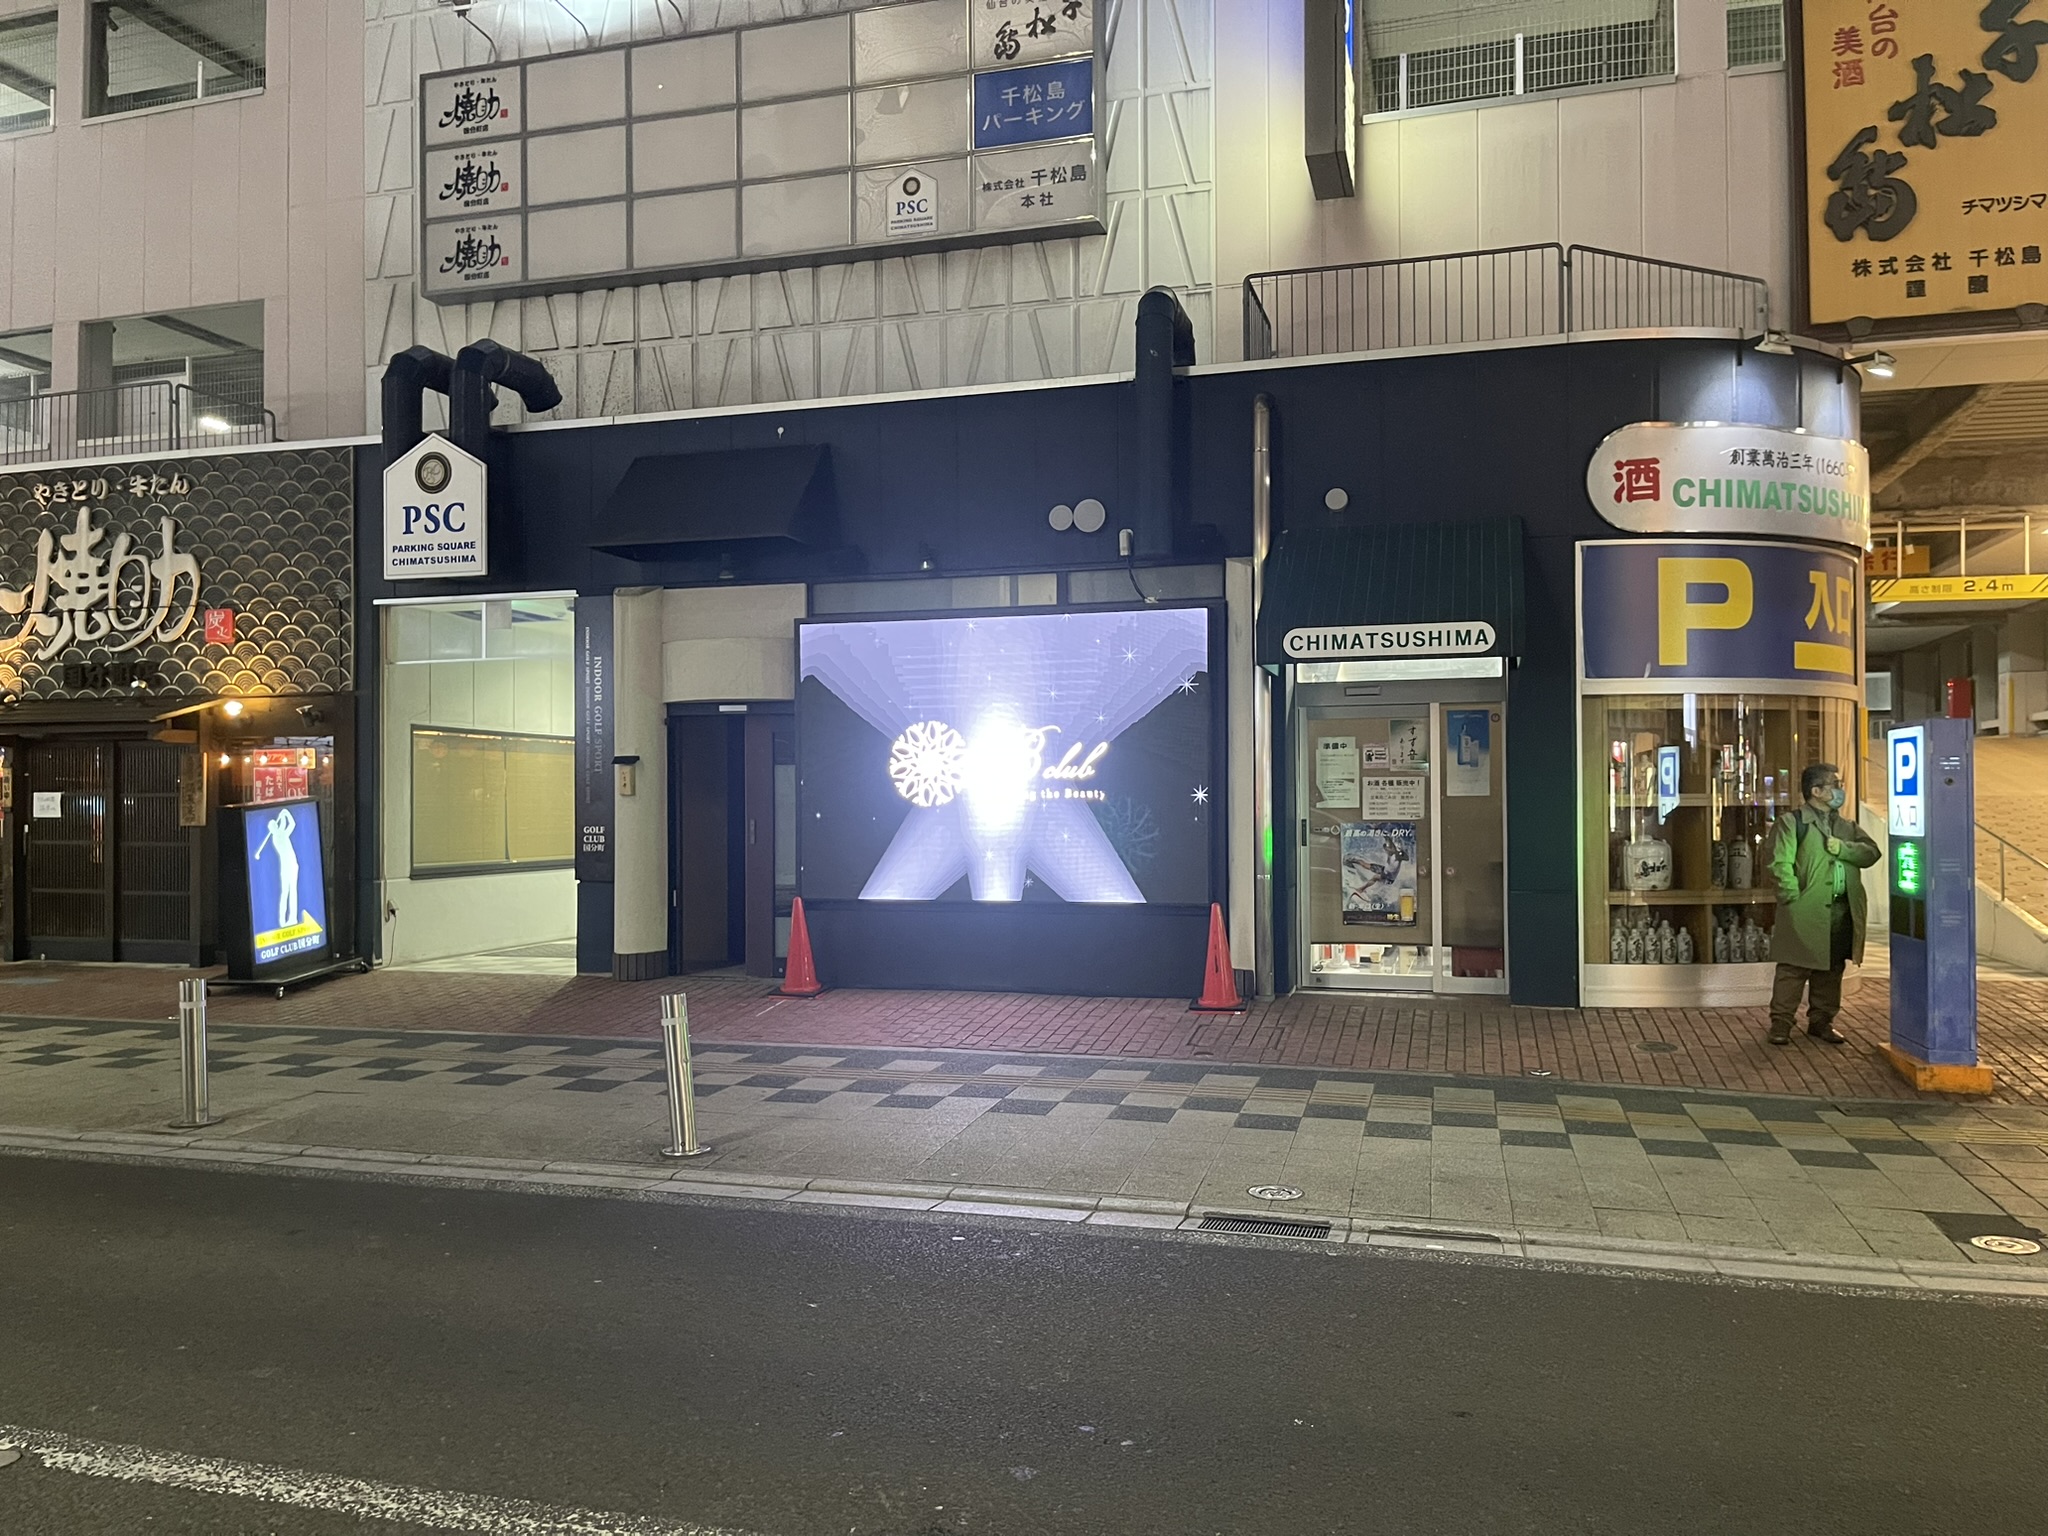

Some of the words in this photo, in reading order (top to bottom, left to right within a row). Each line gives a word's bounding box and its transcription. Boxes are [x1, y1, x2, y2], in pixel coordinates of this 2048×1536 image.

[1867, 0, 1899, 59] 台の
[1831, 25, 1865, 90] 美酒
[1001, 80, 1066, 107] 千松島
[982, 100, 1085, 131] パーキング
[982, 178, 1025, 192] 株式会社
[1031, 164, 1087, 186] 千松島
[896, 199, 928, 216] PSC
[1021, 192, 1054, 208] 本社
[1961, 193, 2047, 215] チマツシマ
[1851, 252, 1953, 278] 株式会社
[1968, 245, 2042, 268] 千松島
[1730, 449, 1856, 478] 創業萬治三年(1660
[33, 473, 190, 505] やきとり・牛たん
[1613, 457, 1660, 503] 酒
[402, 502, 466, 535] PSC
[392, 543, 434, 553] PARKING
[437, 541, 476, 551] SQUARE
[392, 554, 477, 567] CHIMATSUSHIMA
[1909, 583, 1953, 595] 高さ制限
[1658, 557, 1753, 666] P
[1804, 570, 1854, 637] 入口
[1290, 628, 1489, 652] CHIMATSUSHIMA
[594, 656, 602, 702] INDOOR
[1896, 741, 1916, 793] P
[1041, 788, 1060, 799] the
[1064, 788, 1105, 801] Beauty
[1895, 804, 1917, 827] 入口
[583, 825, 605, 834] GOLF
[583, 835, 605, 843] CLUB
[583, 844, 605, 852] 国分町
[261, 947, 279, 960] GOLF
[280, 942, 298, 954] CLUB
